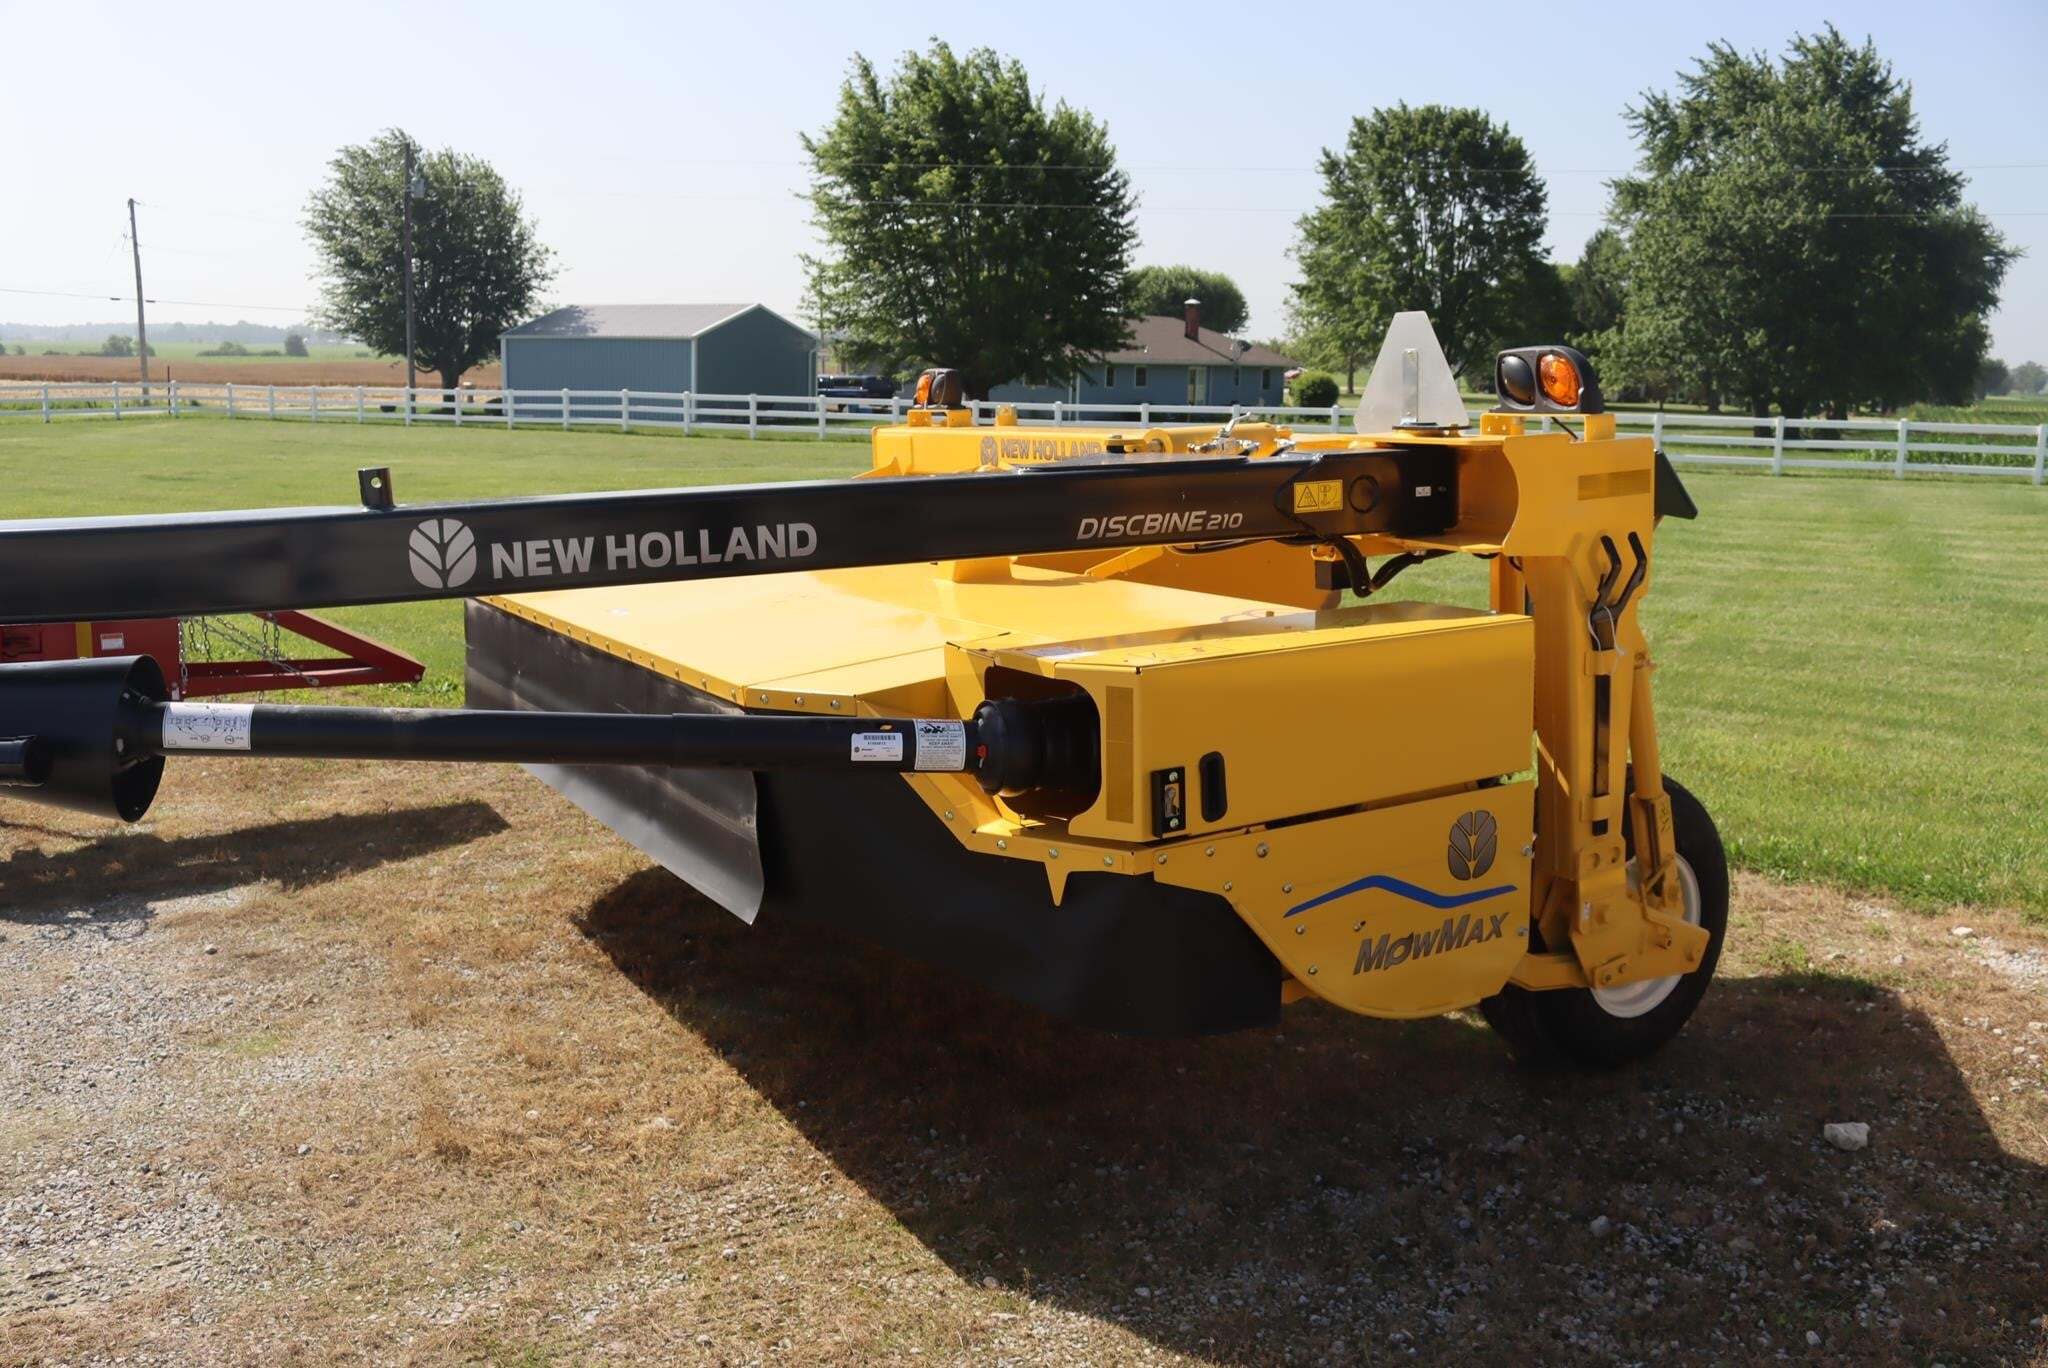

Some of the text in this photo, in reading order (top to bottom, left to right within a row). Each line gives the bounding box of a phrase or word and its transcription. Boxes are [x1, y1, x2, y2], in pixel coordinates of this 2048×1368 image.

[1000, 438, 1030, 460] NEW
[1077, 510, 1244, 540] DISCBINE 210
[490, 523, 818, 579] NEW HOLLAND
